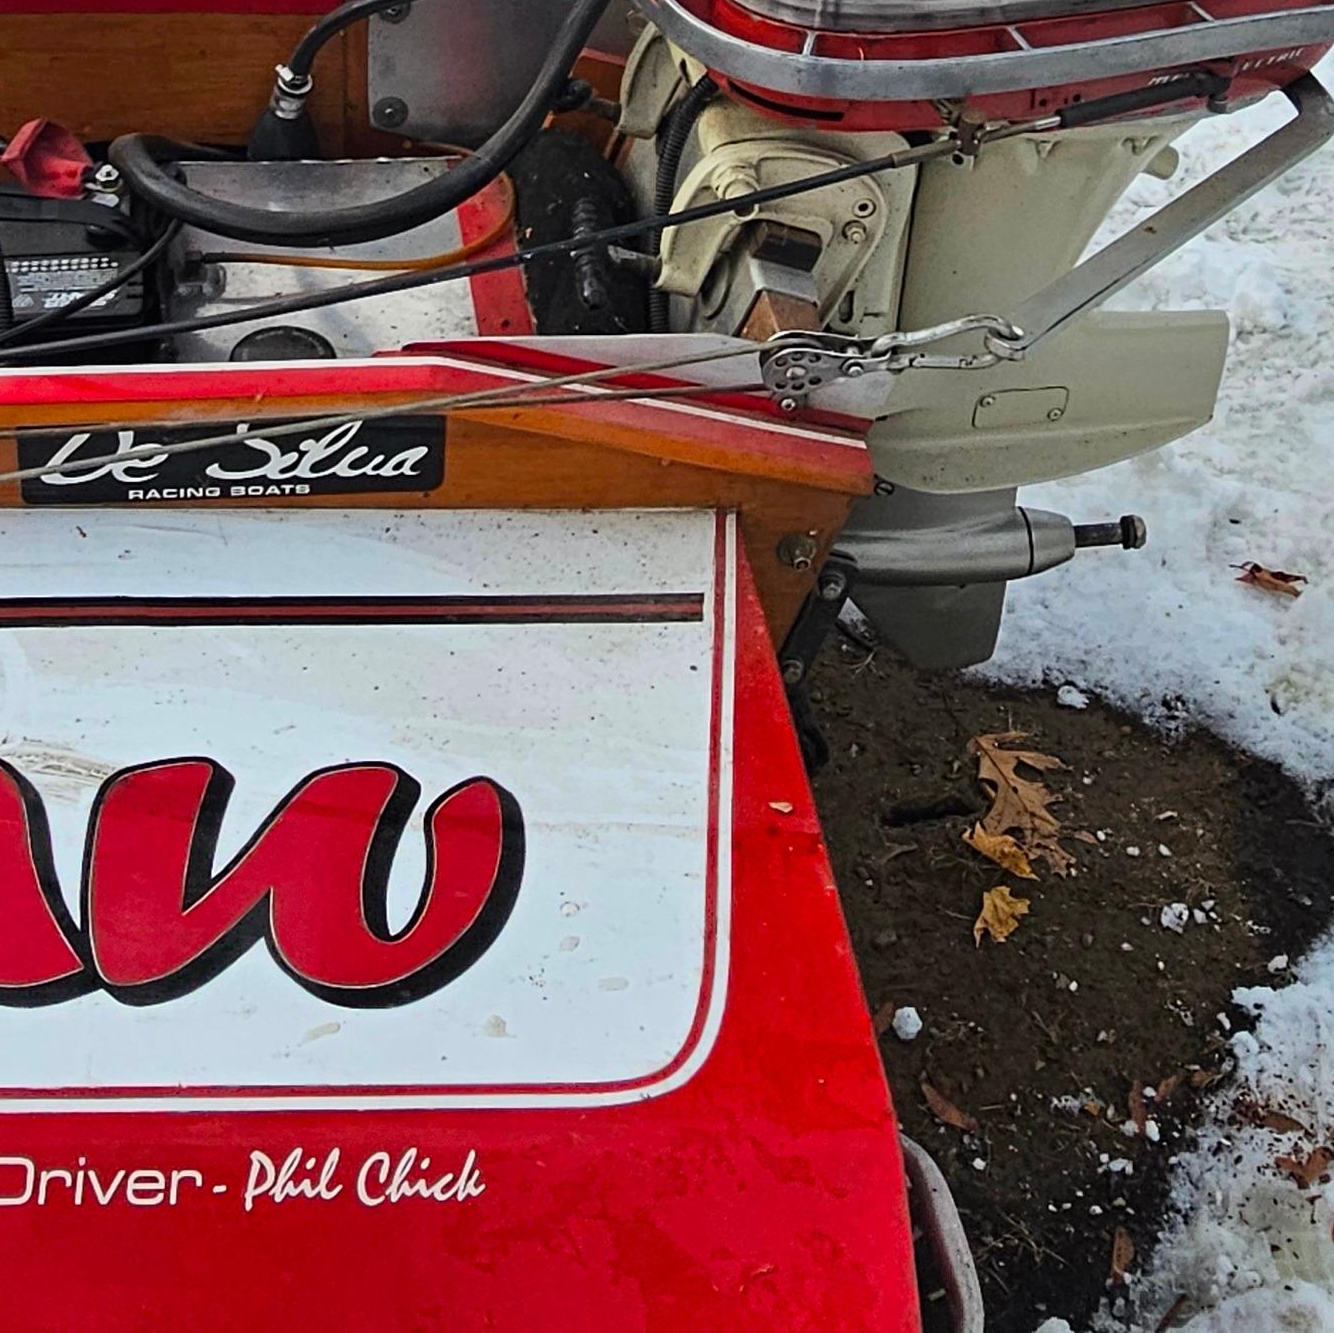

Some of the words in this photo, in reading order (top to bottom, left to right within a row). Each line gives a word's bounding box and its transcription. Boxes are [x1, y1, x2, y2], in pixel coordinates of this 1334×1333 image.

[127, 486, 221, 500] RACING
[230, 483, 311, 497] BOATS
[243, 1147, 342, 1211] Phil
[357, 1147, 485, 1207] Chick
